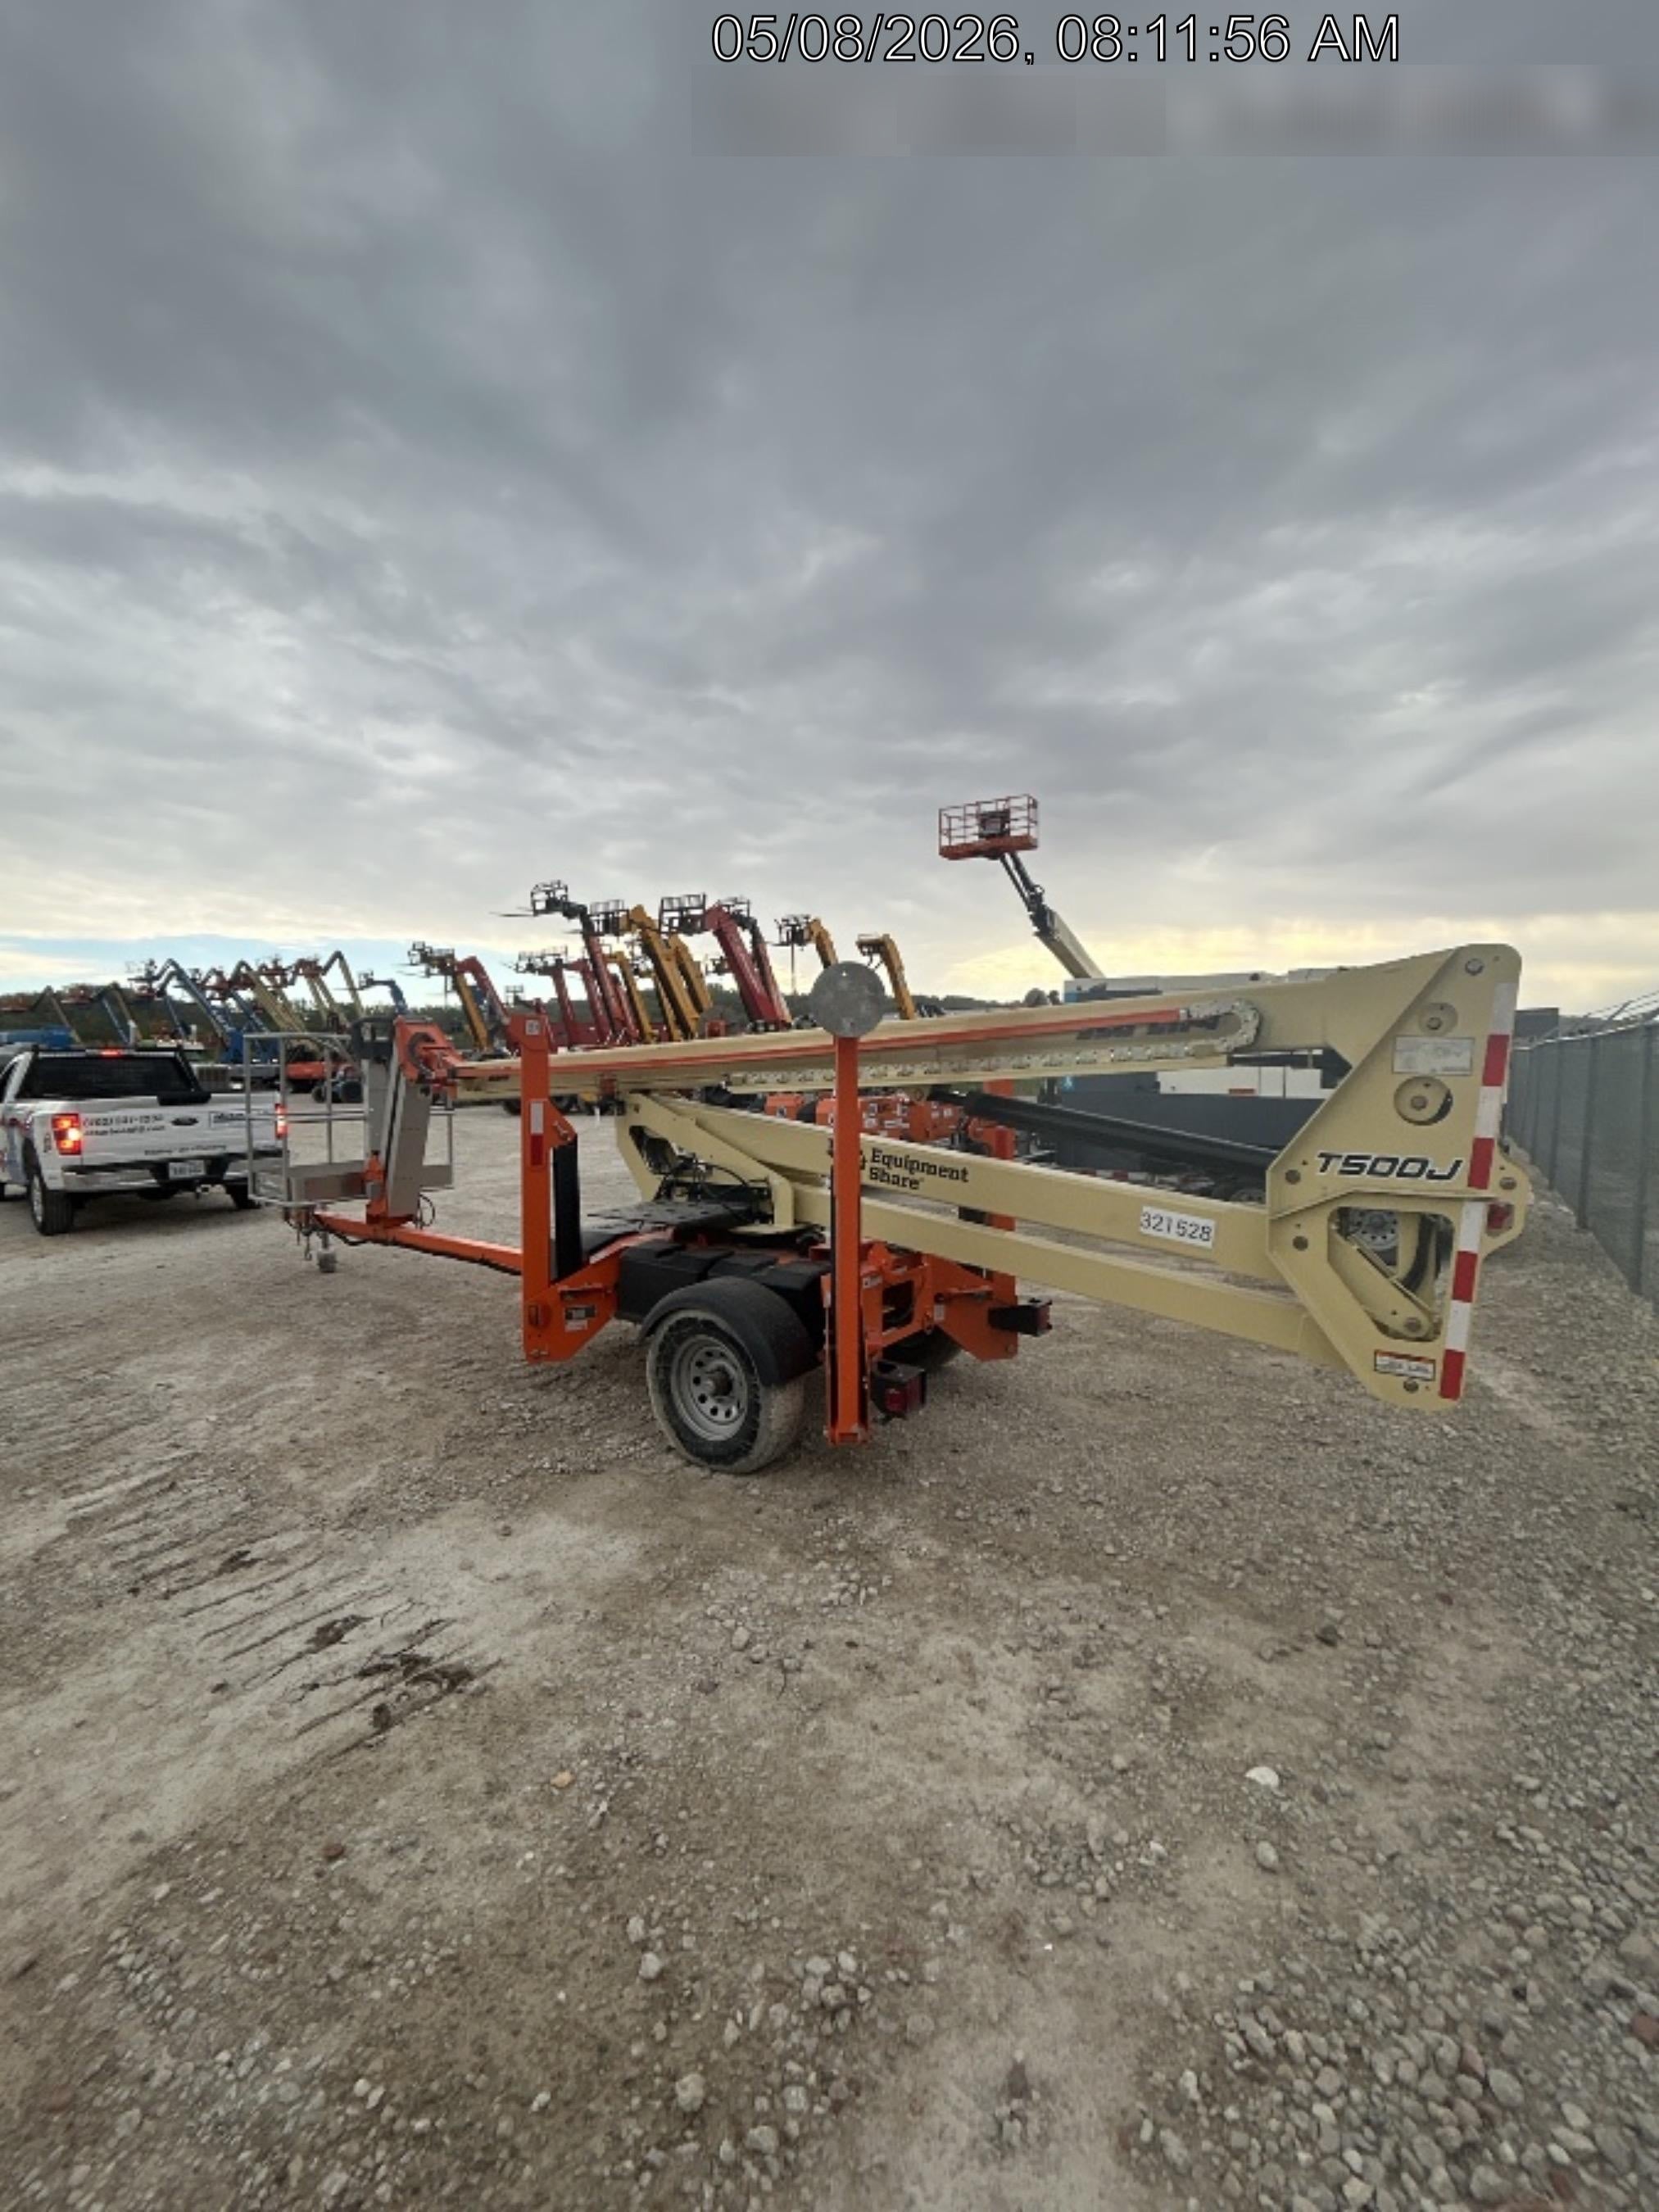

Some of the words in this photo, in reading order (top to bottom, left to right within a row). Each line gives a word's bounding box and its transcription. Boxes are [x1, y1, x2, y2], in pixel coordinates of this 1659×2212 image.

[869, 1167, 921, 1190] Share
[871, 1147, 969, 1183] Equipment
[1317, 1152, 1463, 1180] T500J
